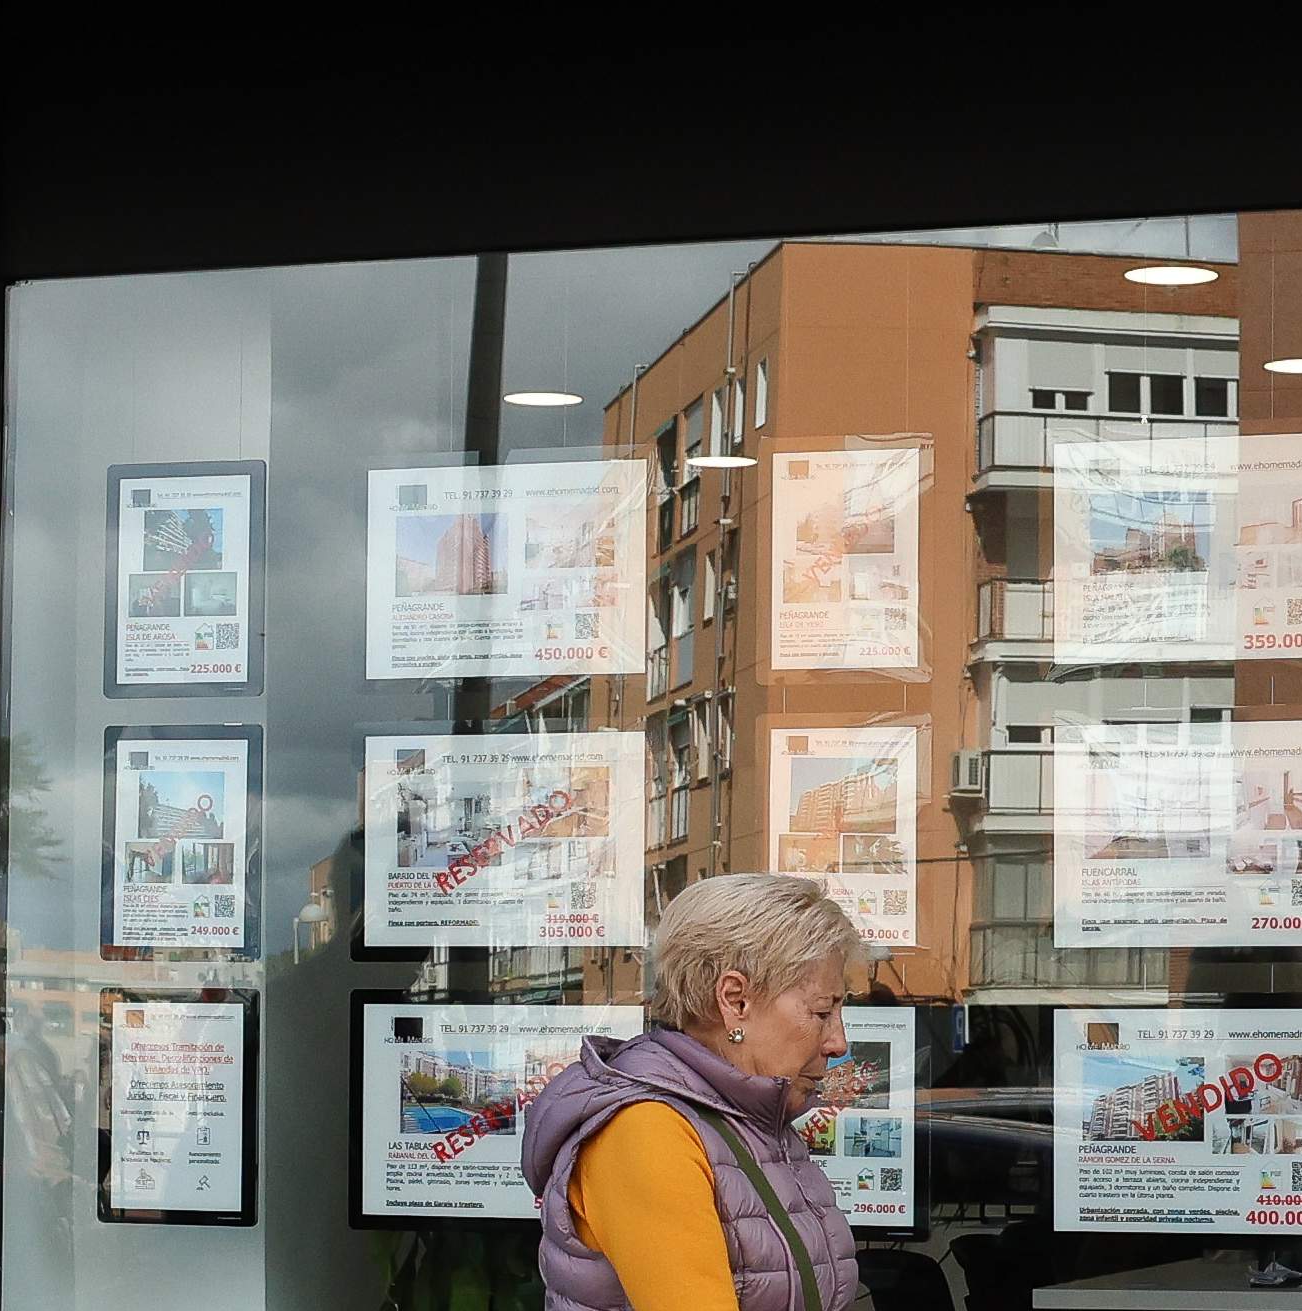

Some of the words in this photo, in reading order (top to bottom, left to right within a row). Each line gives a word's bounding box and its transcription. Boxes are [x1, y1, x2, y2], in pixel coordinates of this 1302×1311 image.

[445, 492, 459, 500] TEL.
[463, 490, 472, 498] 91
[475, 490, 490, 498] 737
[534, 647, 593, 660] 450.000
[598, 647, 608, 659] €
[859, 646, 901, 656] 225.000
[904, 646, 911, 656] €
[191, 664, 232, 674] 225.000
[235, 664, 241, 672] €
[442, 755, 459, 763] TEL.
[461, 755, 470, 763] 91
[474, 755, 487, 763] 737
[490, 754, 499, 762] 39
[436, 790, 572, 895] RESERVADO
[388, 872, 413, 880] BARRIO
[416, 872, 430, 880] DEL
[1082, 868, 1137, 877] FUENCARRAL
[190, 926, 230, 936] 249.000
[233, 926, 239, 935] €
[539, 926, 593, 937] 305.000
[596, 926, 605, 937] €
[902, 929, 910, 939] €
[440, 1025, 456, 1033] TEL.
[471, 1025, 485, 1033] 737
[487, 1025, 497, 1033] 39
[499, 1025, 509, 1033] 29
[1138, 1030, 1155, 1039] TEL.
[1159, 1030, 1168, 1039] 91
[1172, 1031, 1187, 1039] 737
[1190, 1031, 1201, 1039] 39
[1204, 1031, 1214, 1039] 29
[215, 1044, 224, 1052] de
[1131, 1053, 1283, 1141] VENDIDO
[388, 1142, 402, 1150] LAS
[406, 1142, 432, 1150] TABLAS
[1079, 1145, 1136, 1154] PEÑAGRANDE
[854, 1203, 896, 1214] 296.000
[898, 1205, 906, 1214] €
